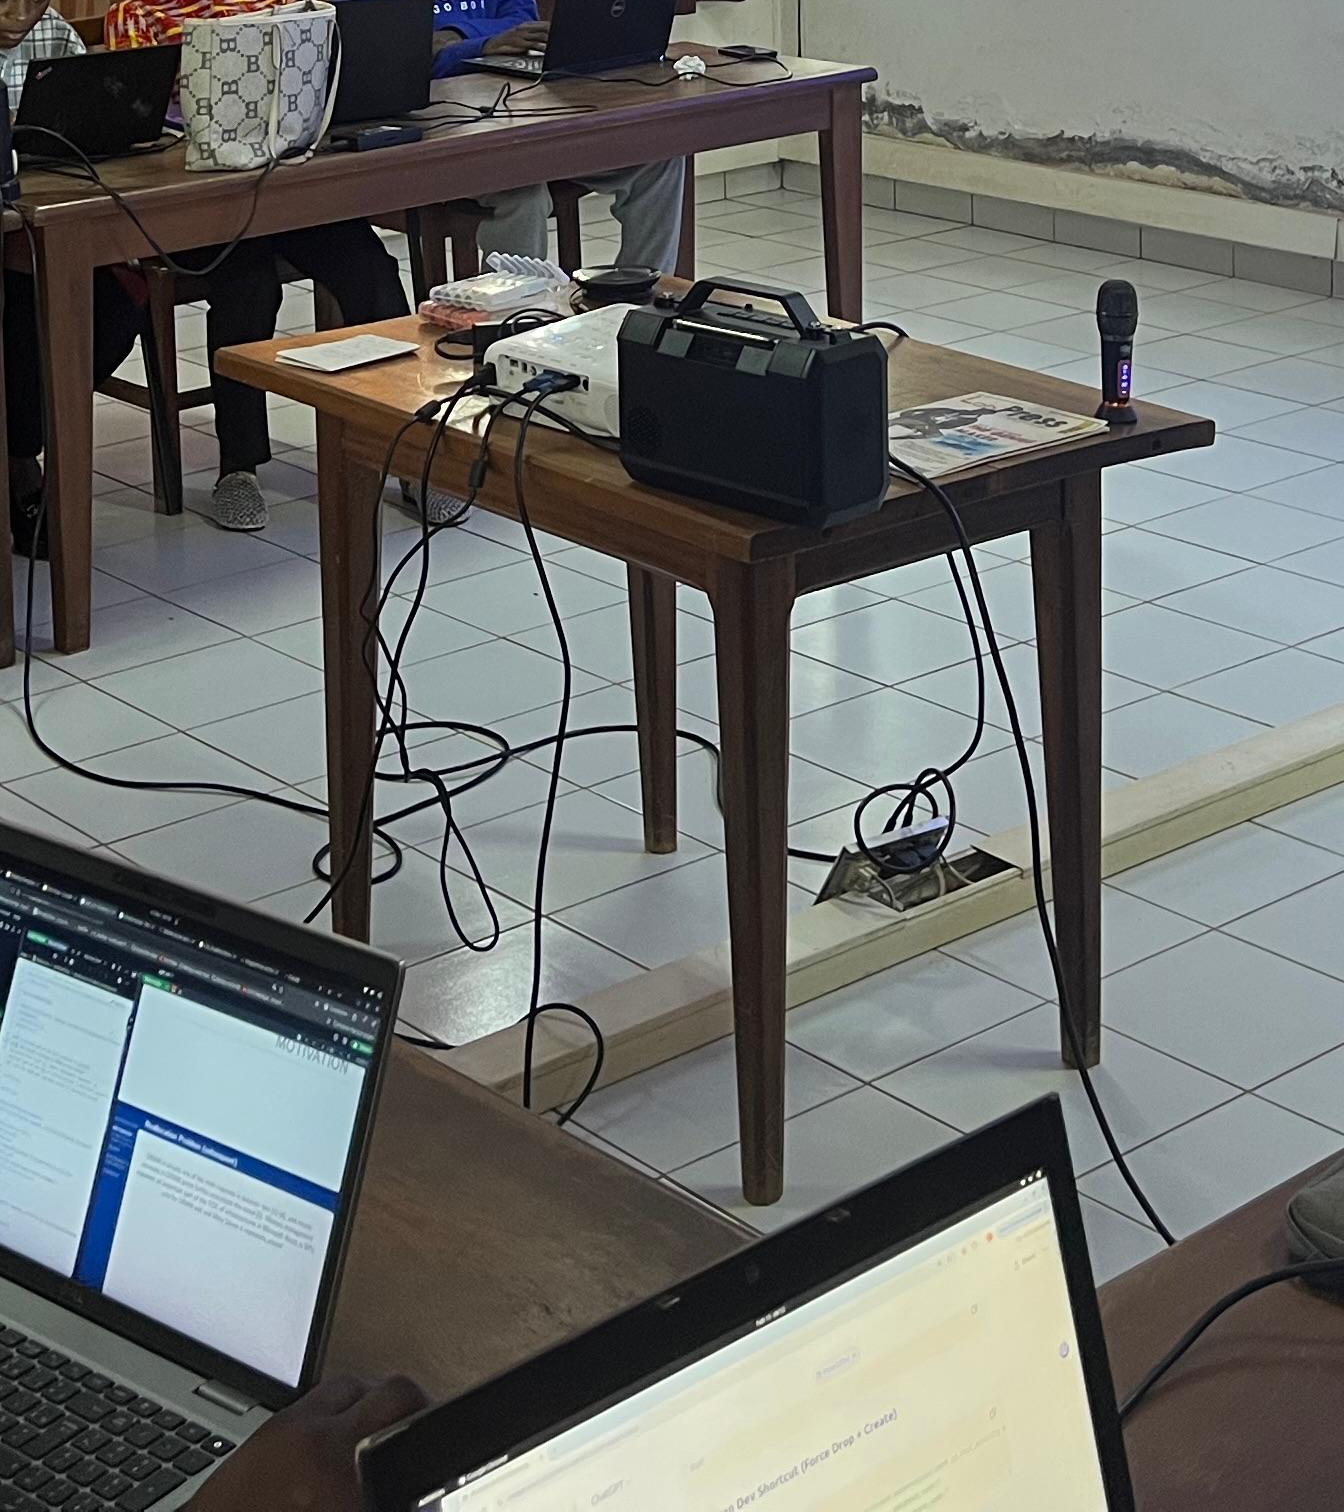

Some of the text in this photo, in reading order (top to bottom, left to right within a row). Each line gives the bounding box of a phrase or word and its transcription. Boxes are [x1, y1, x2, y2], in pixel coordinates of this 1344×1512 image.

[275, 1035, 349, 1075] MOTIVATION
[736, 1491, 756, 1510] Dev
[757, 1466, 799, 1498] Shortcut
[800, 1450, 830, 1475] (Force
[832, 1435, 855, 1455] Drop
[864, 1408, 898, 1435] Create)
